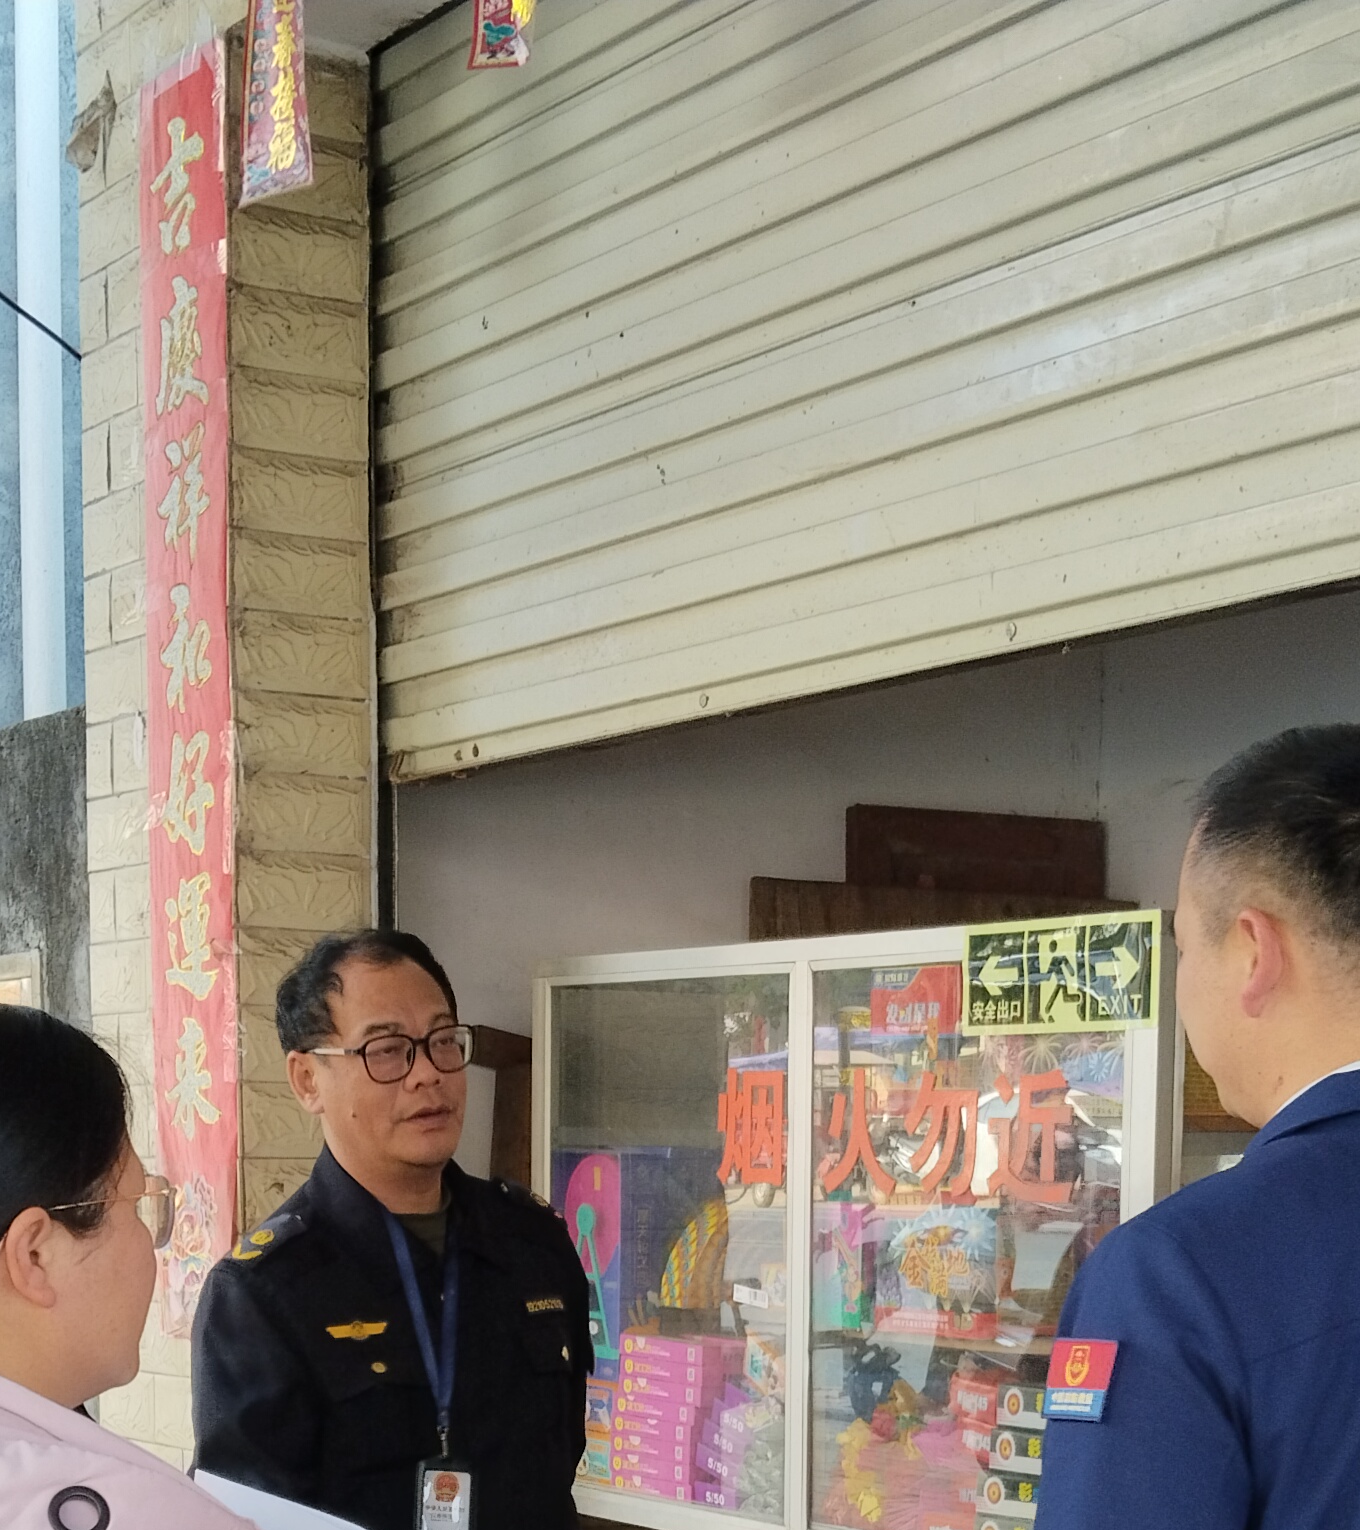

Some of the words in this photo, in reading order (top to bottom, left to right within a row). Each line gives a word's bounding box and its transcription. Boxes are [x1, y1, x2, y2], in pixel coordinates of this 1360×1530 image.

[972, 1000, 1022, 1021] 安全出口
[1098, 993, 1142, 1016] EXIT
[716, 1068, 1075, 1204] 烟火勿近
[713, 1433, 734, 1454] 5/50
[707, 1457, 728, 1477] 5/50
[705, 1491, 725, 1506] 5/50
